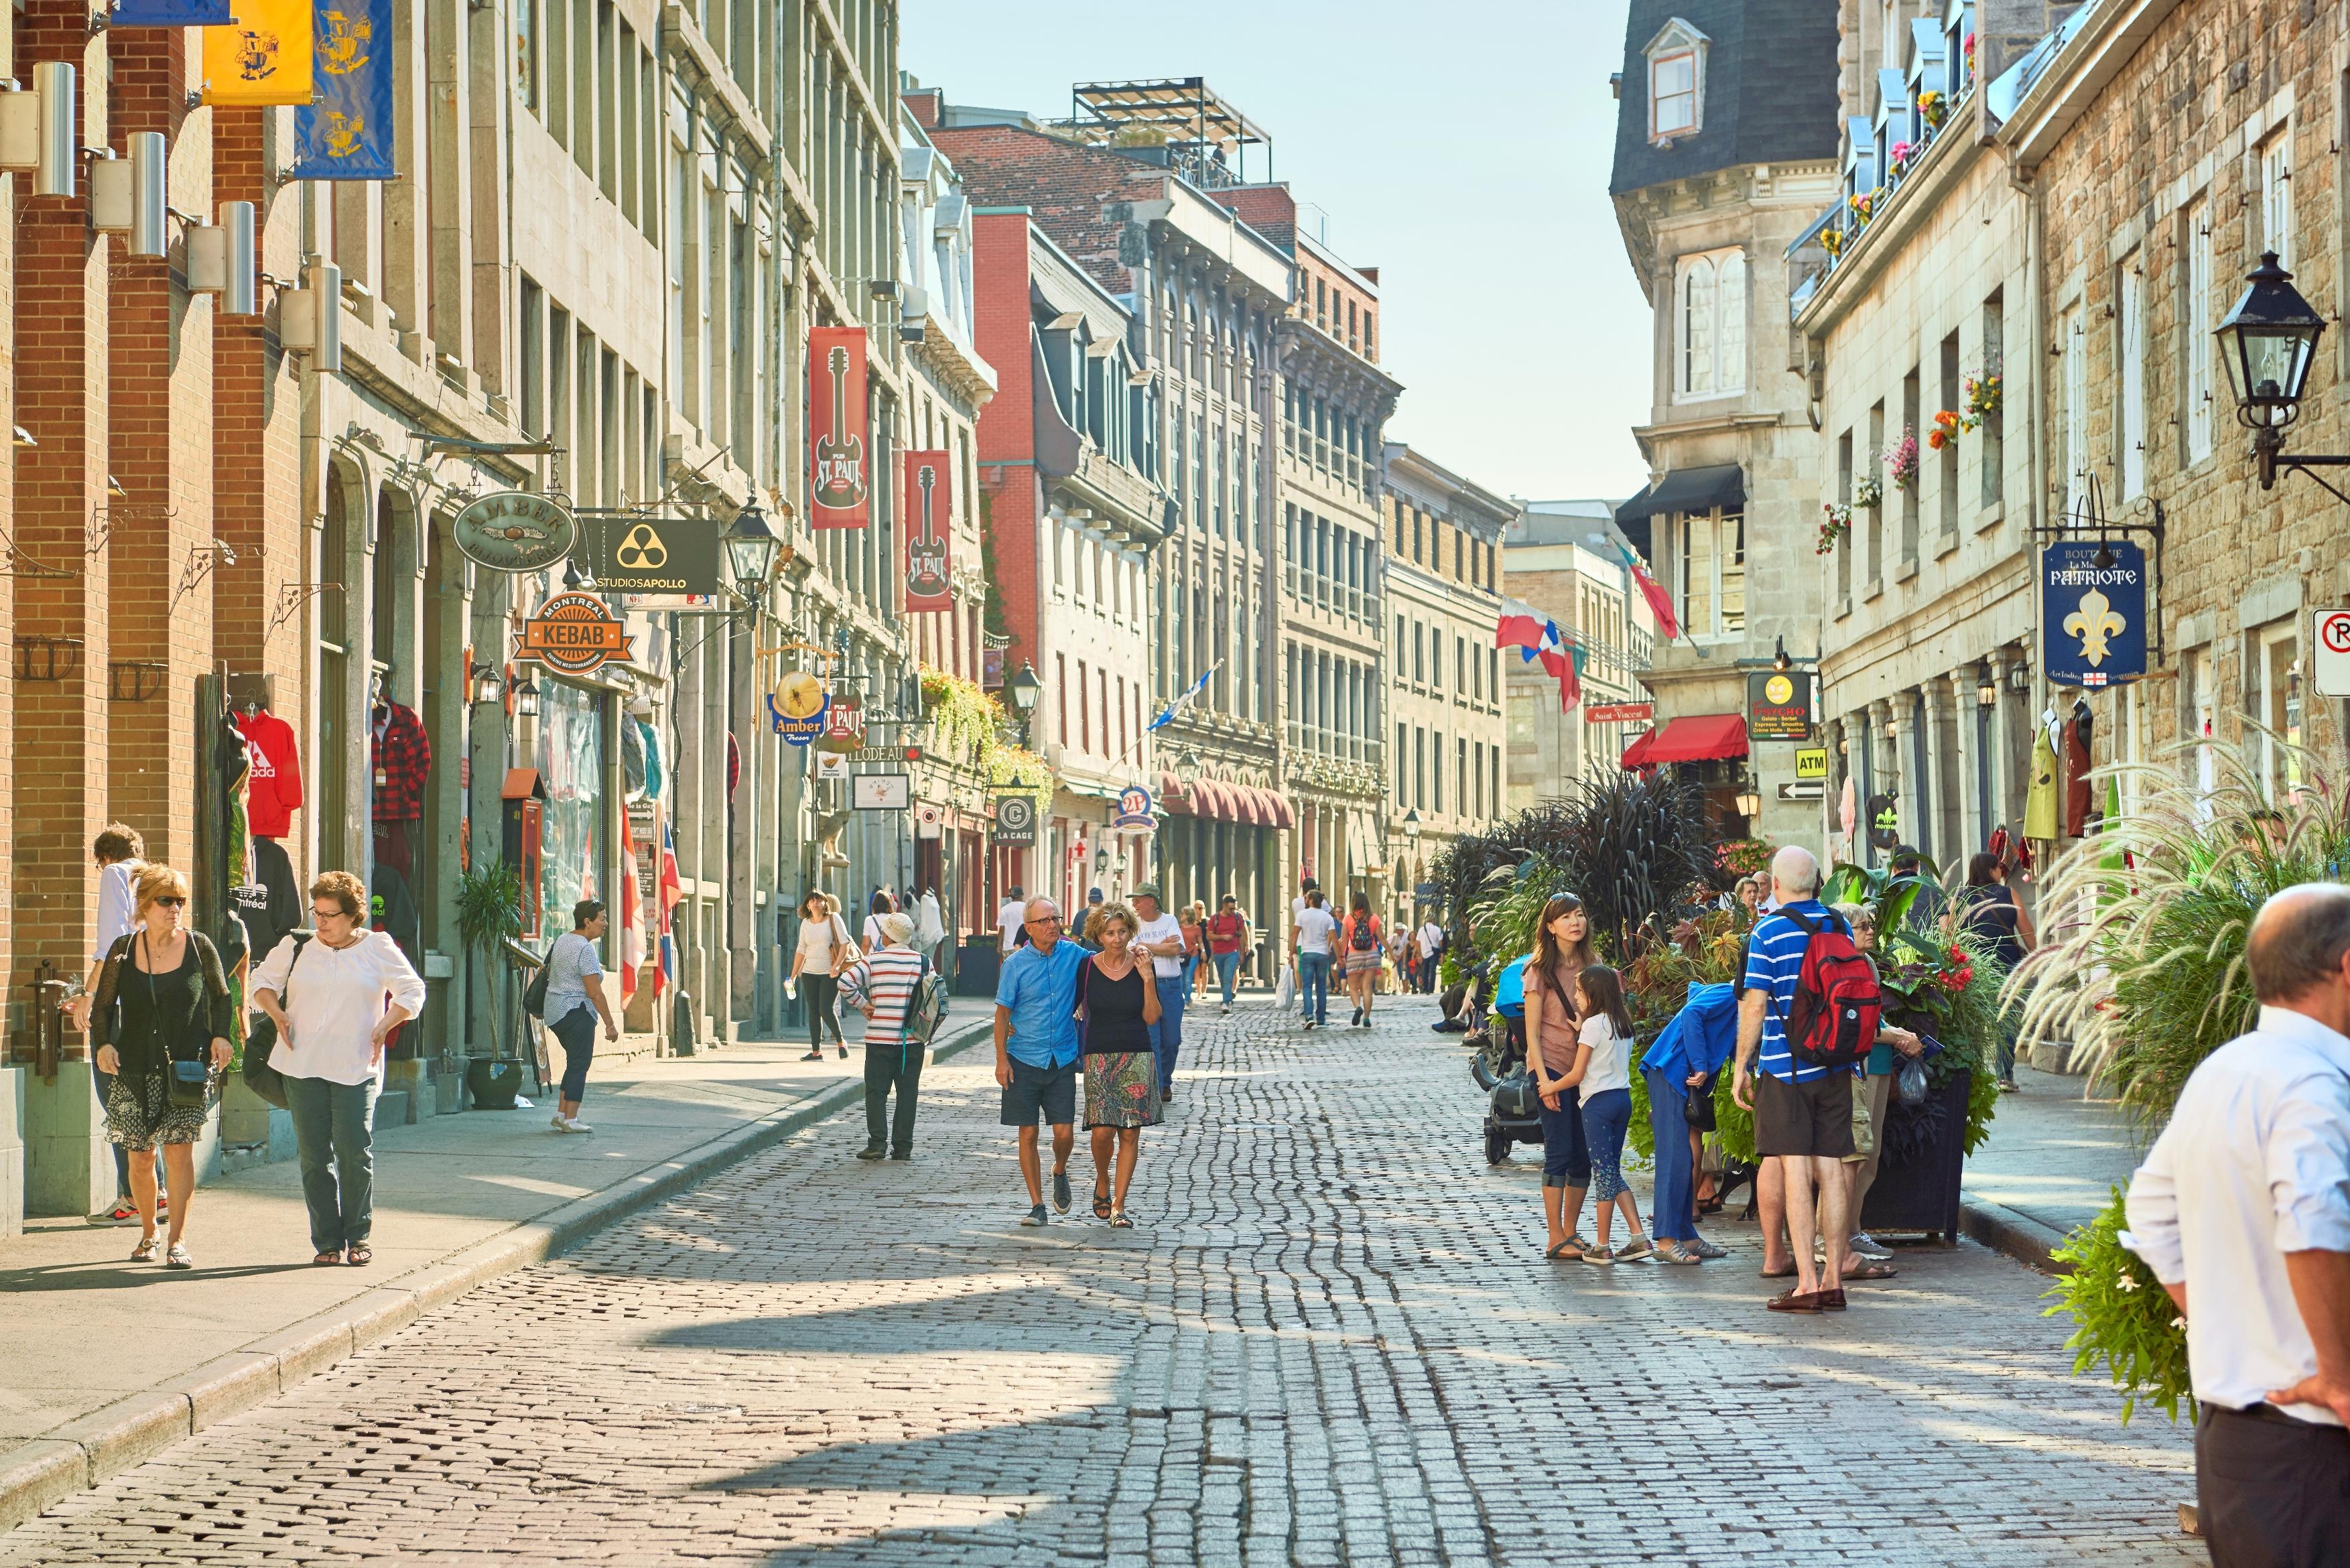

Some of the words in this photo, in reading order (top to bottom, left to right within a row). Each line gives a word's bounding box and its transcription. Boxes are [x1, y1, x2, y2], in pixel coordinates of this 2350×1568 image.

[818, 460, 832, 492] ST.
[835, 460, 862, 493] PAUL
[467, 499, 564, 533] AMBER
[2065, 549, 2123, 559] BOUTUE
[911, 557, 922, 583] ST.
[924, 557, 945, 583] PAUL
[2051, 570, 2136, 585] PATRIOTE
[544, 596, 603, 618] MONTREAL
[543, 625, 604, 645] KEBAB
[547, 653, 562, 665] CUISINE
[2061, 671, 2082, 681] Indien
[1594, 710, 1642, 720] Saint-Vincent
[1753, 708, 1805, 716] PSYCHO
[775, 719, 821, 732] Amber
[836, 710, 861, 739] PAUL
[848, 747, 903, 761] ILODEAU
[1799, 757, 1824, 770] ATM
[1123, 795, 1145, 813] 2P
